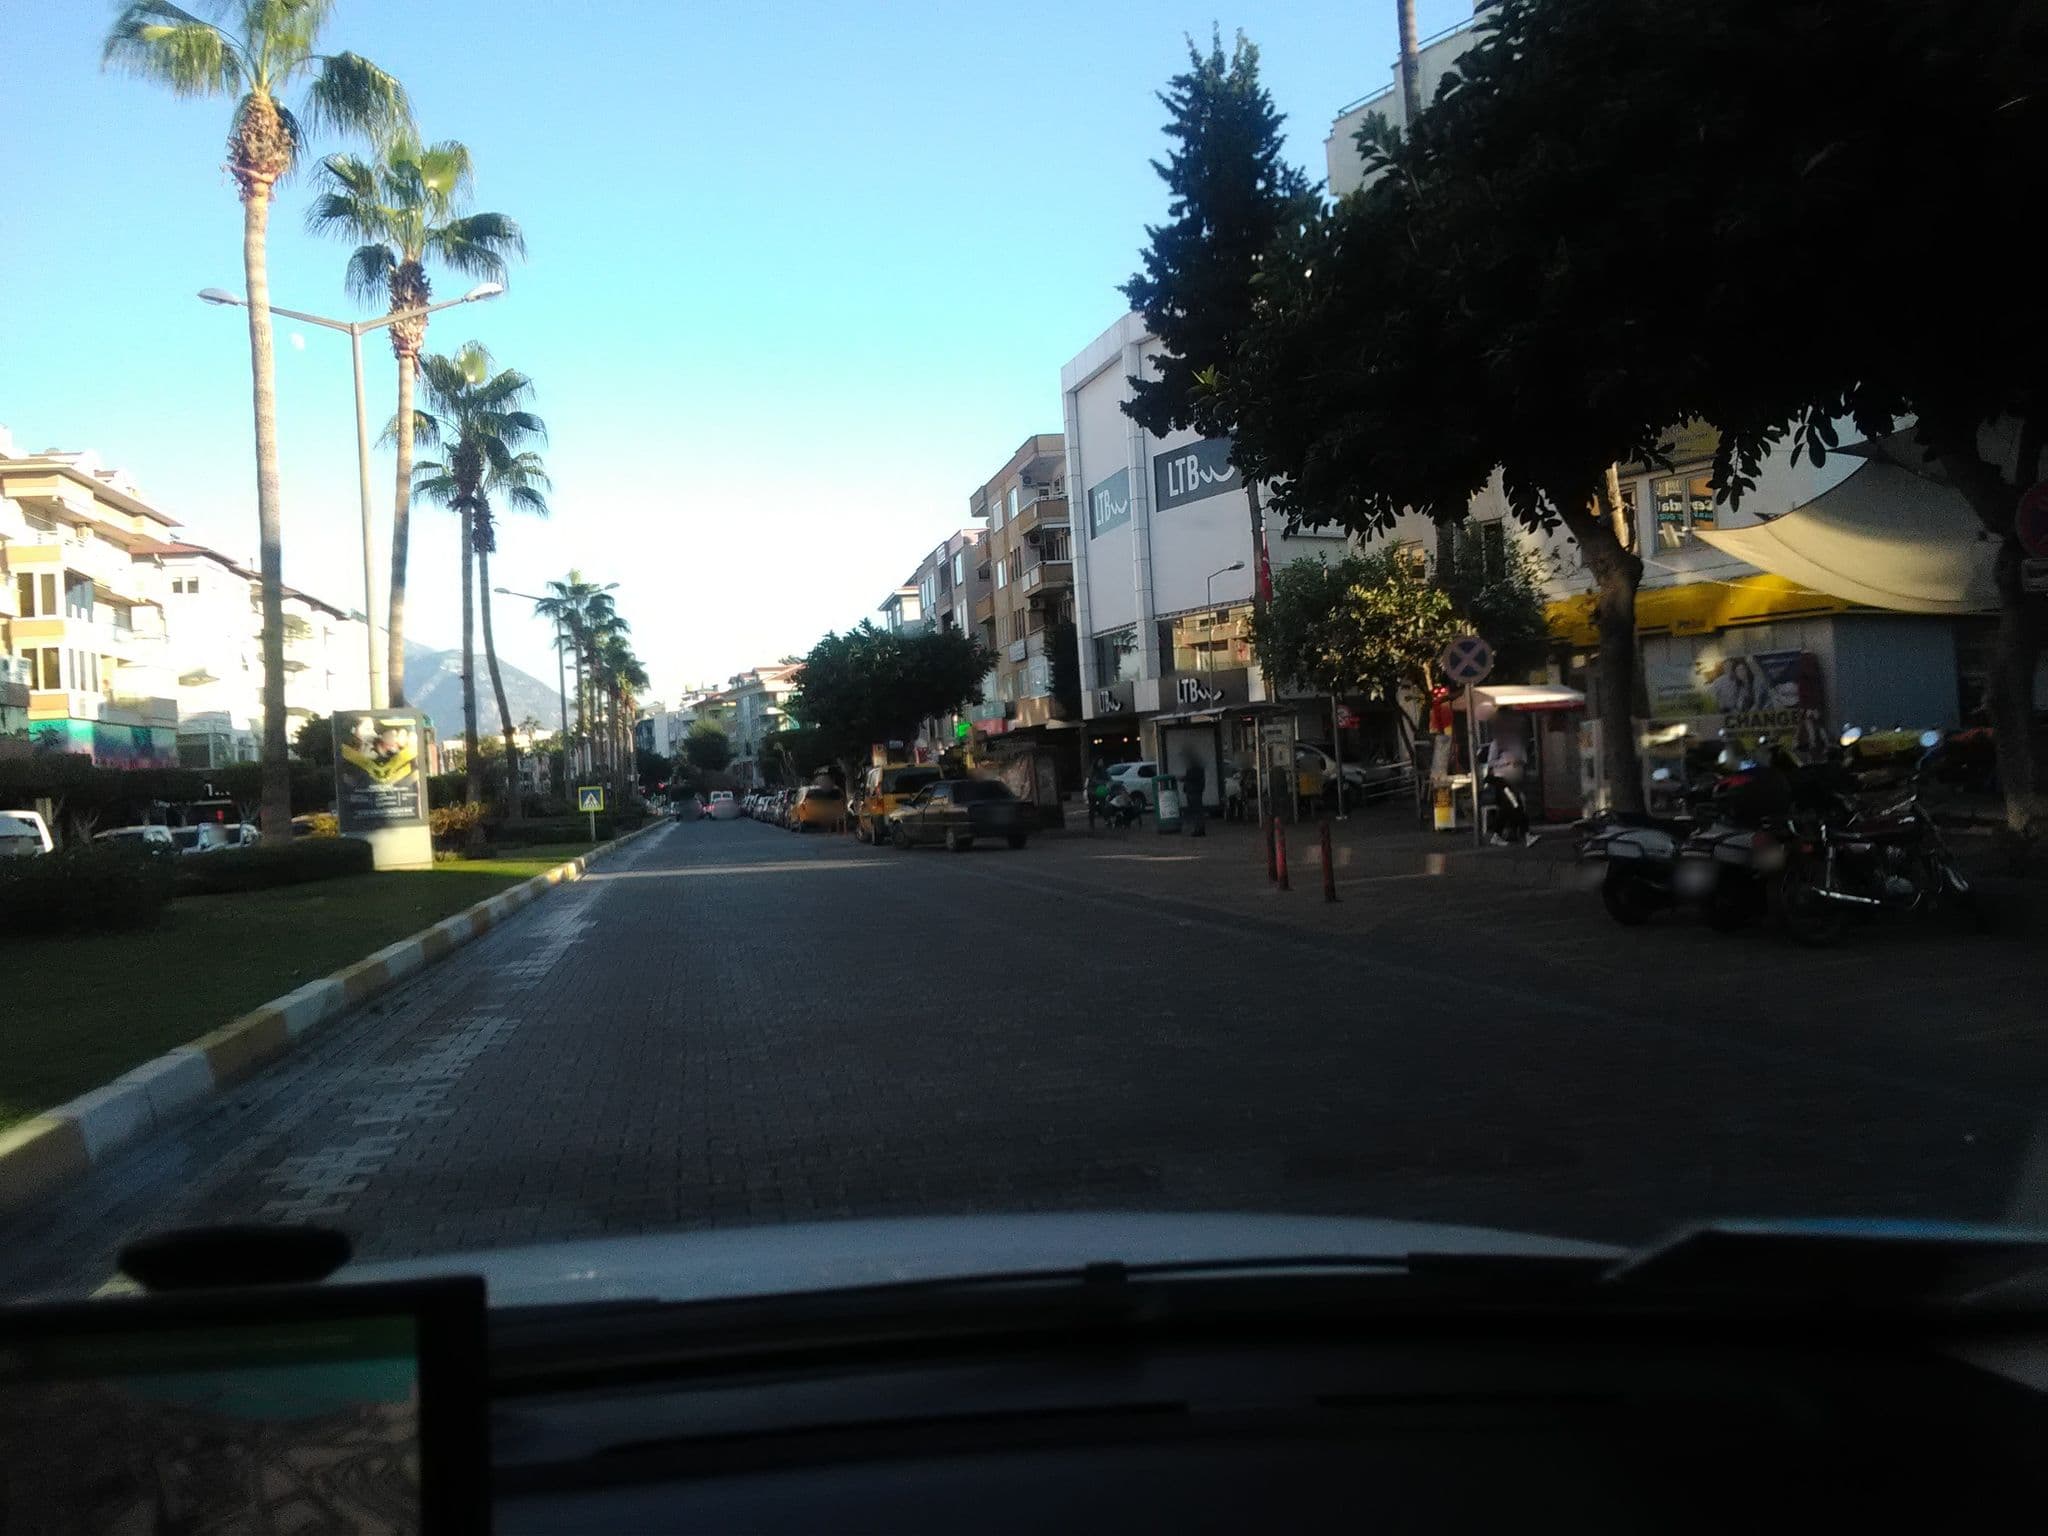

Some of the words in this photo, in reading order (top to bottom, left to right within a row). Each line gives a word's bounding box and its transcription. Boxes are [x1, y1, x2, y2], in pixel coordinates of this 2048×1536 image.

[1168, 455, 1199, 497] LTB
[1095, 490, 1110, 526] LTB
[1177, 679, 1198, 703] LTB
